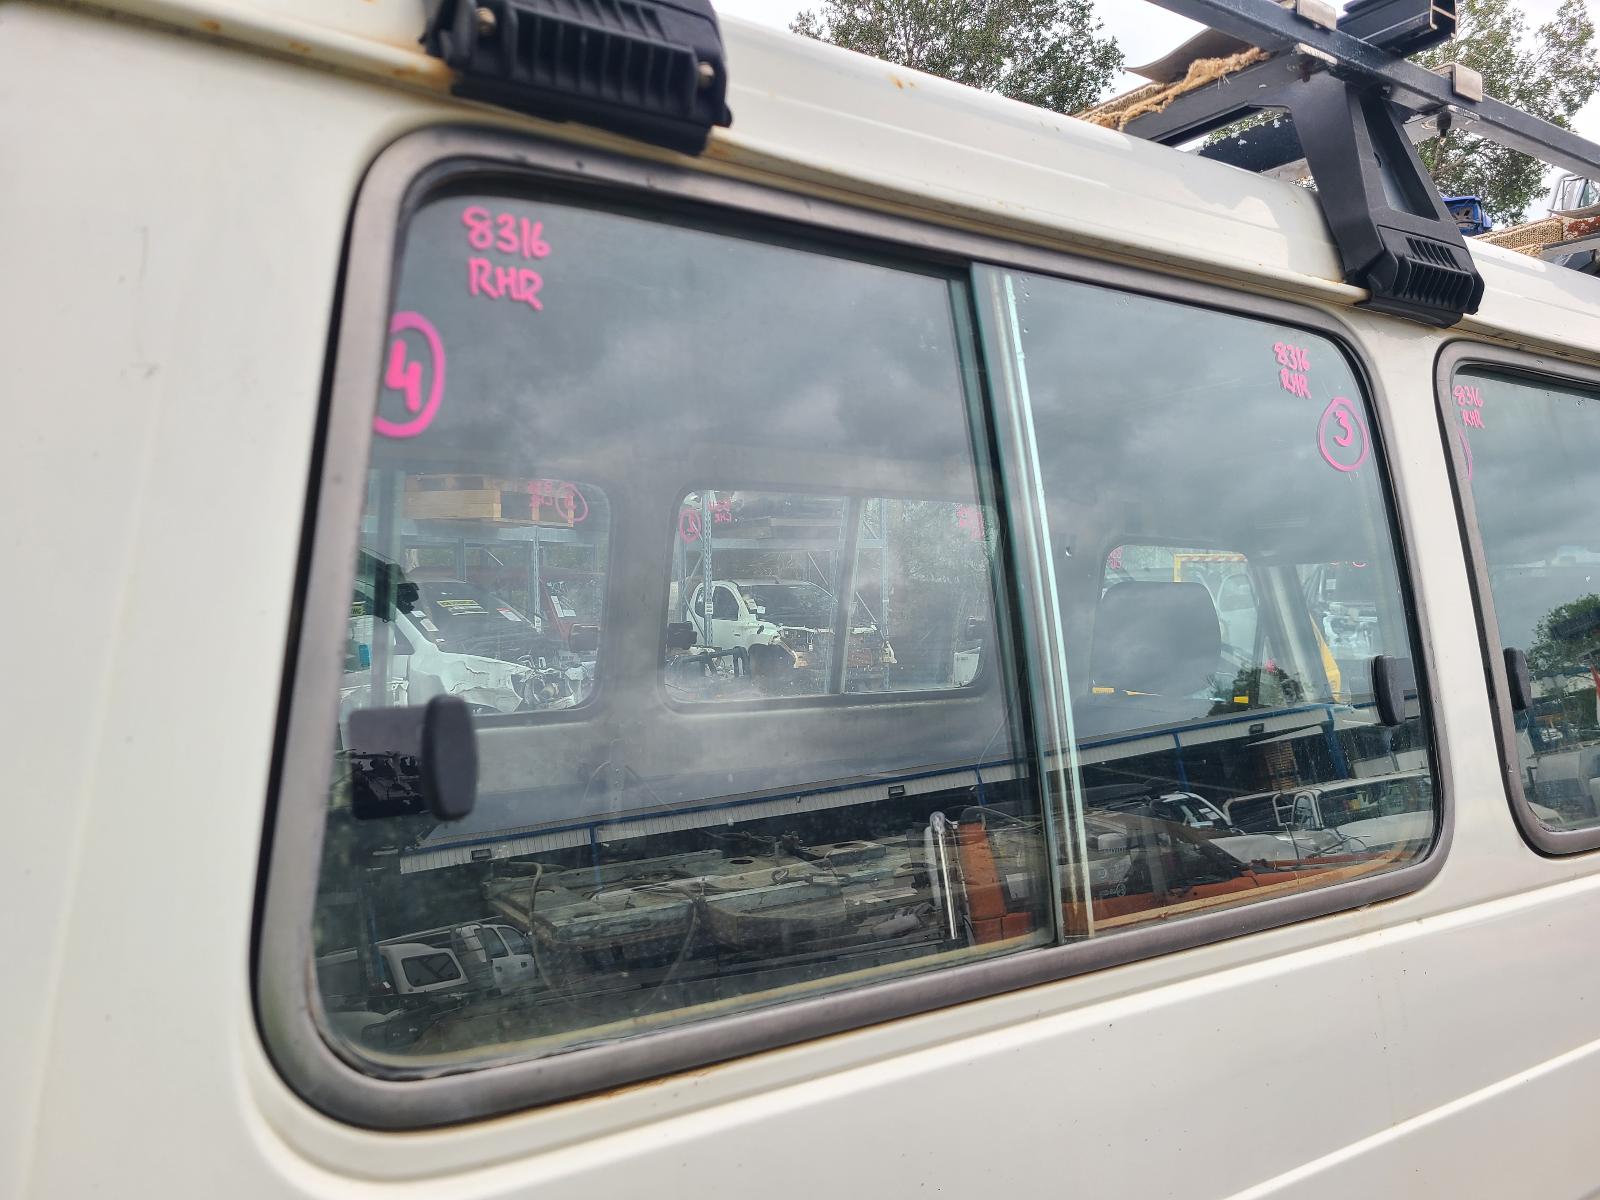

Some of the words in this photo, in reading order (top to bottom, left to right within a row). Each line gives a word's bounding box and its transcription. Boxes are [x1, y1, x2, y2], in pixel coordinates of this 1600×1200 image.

[462, 206, 551, 258] 8316
[469, 257, 543, 310] RHR
[385, 339, 422, 412] 4
[1274, 342, 1310, 371] 8316
[1333, 410, 1354, 447] 3
